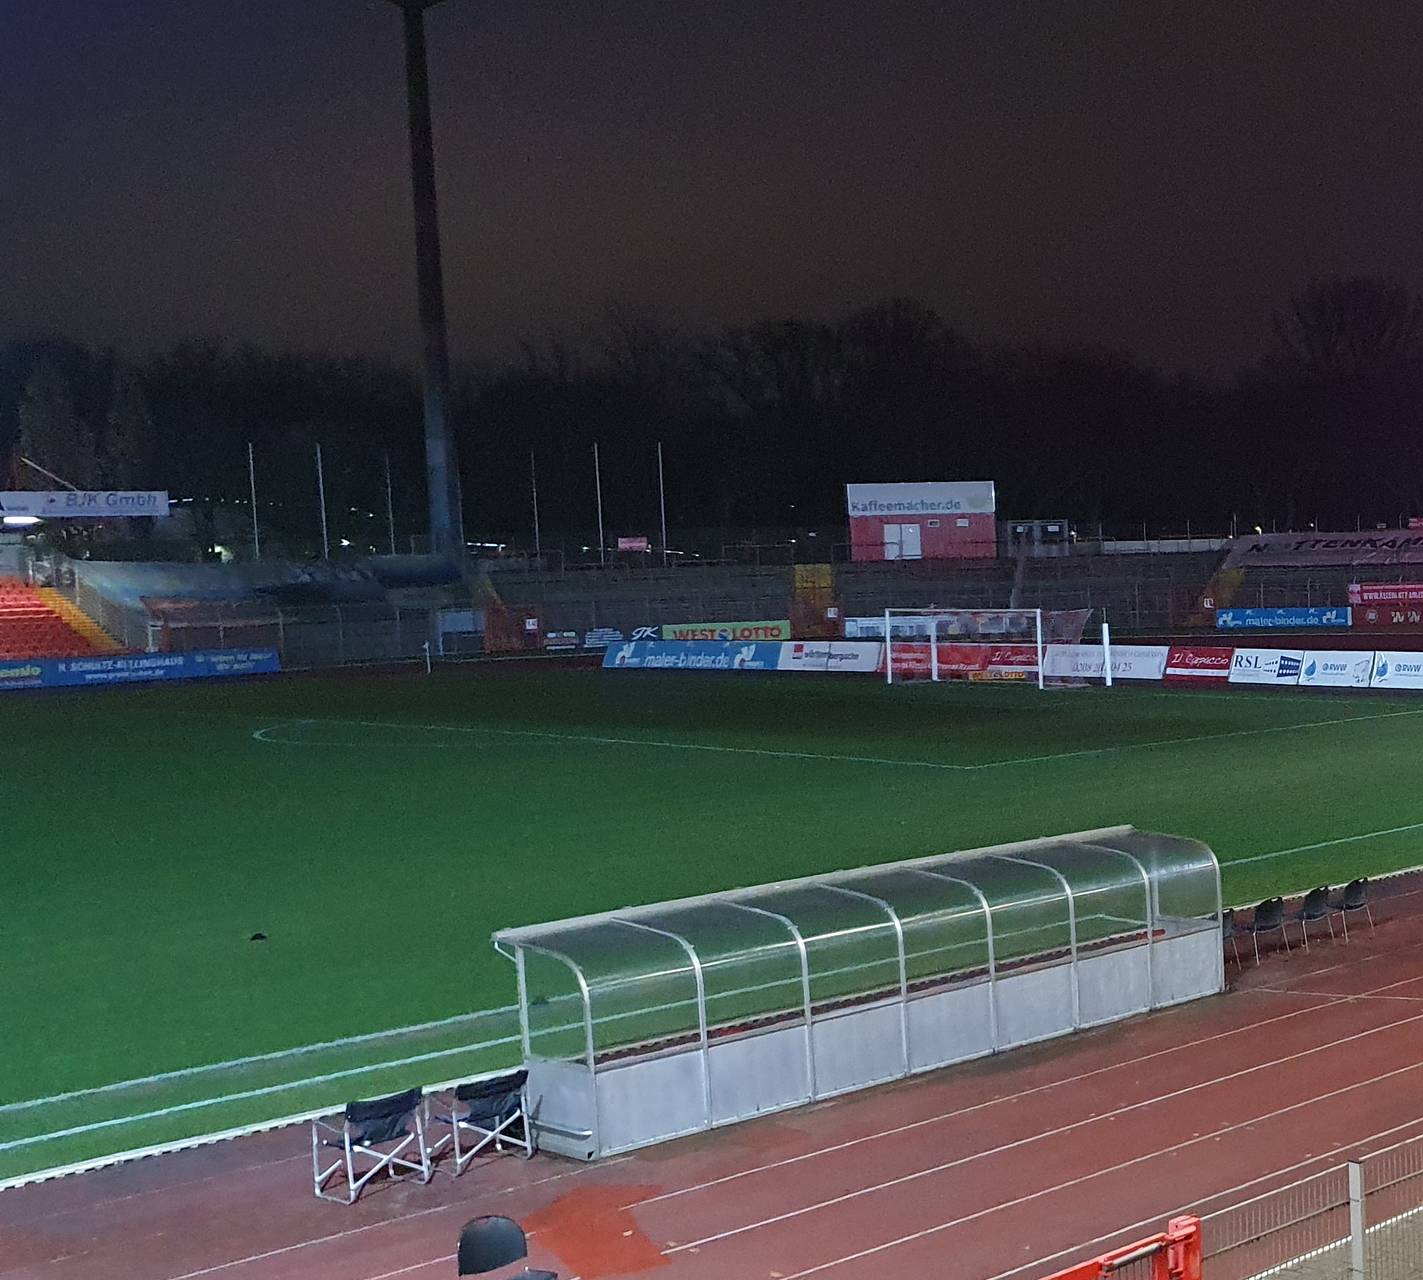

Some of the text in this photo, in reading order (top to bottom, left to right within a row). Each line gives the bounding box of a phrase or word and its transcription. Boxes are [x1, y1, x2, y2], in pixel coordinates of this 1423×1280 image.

[851, 499, 962, 512] Kaffeemacher.de
[672, 626, 782, 640] WEST LOTTO
[642, 652, 730, 668] maler-binder.de
[1234, 654, 1262, 669] RSL
